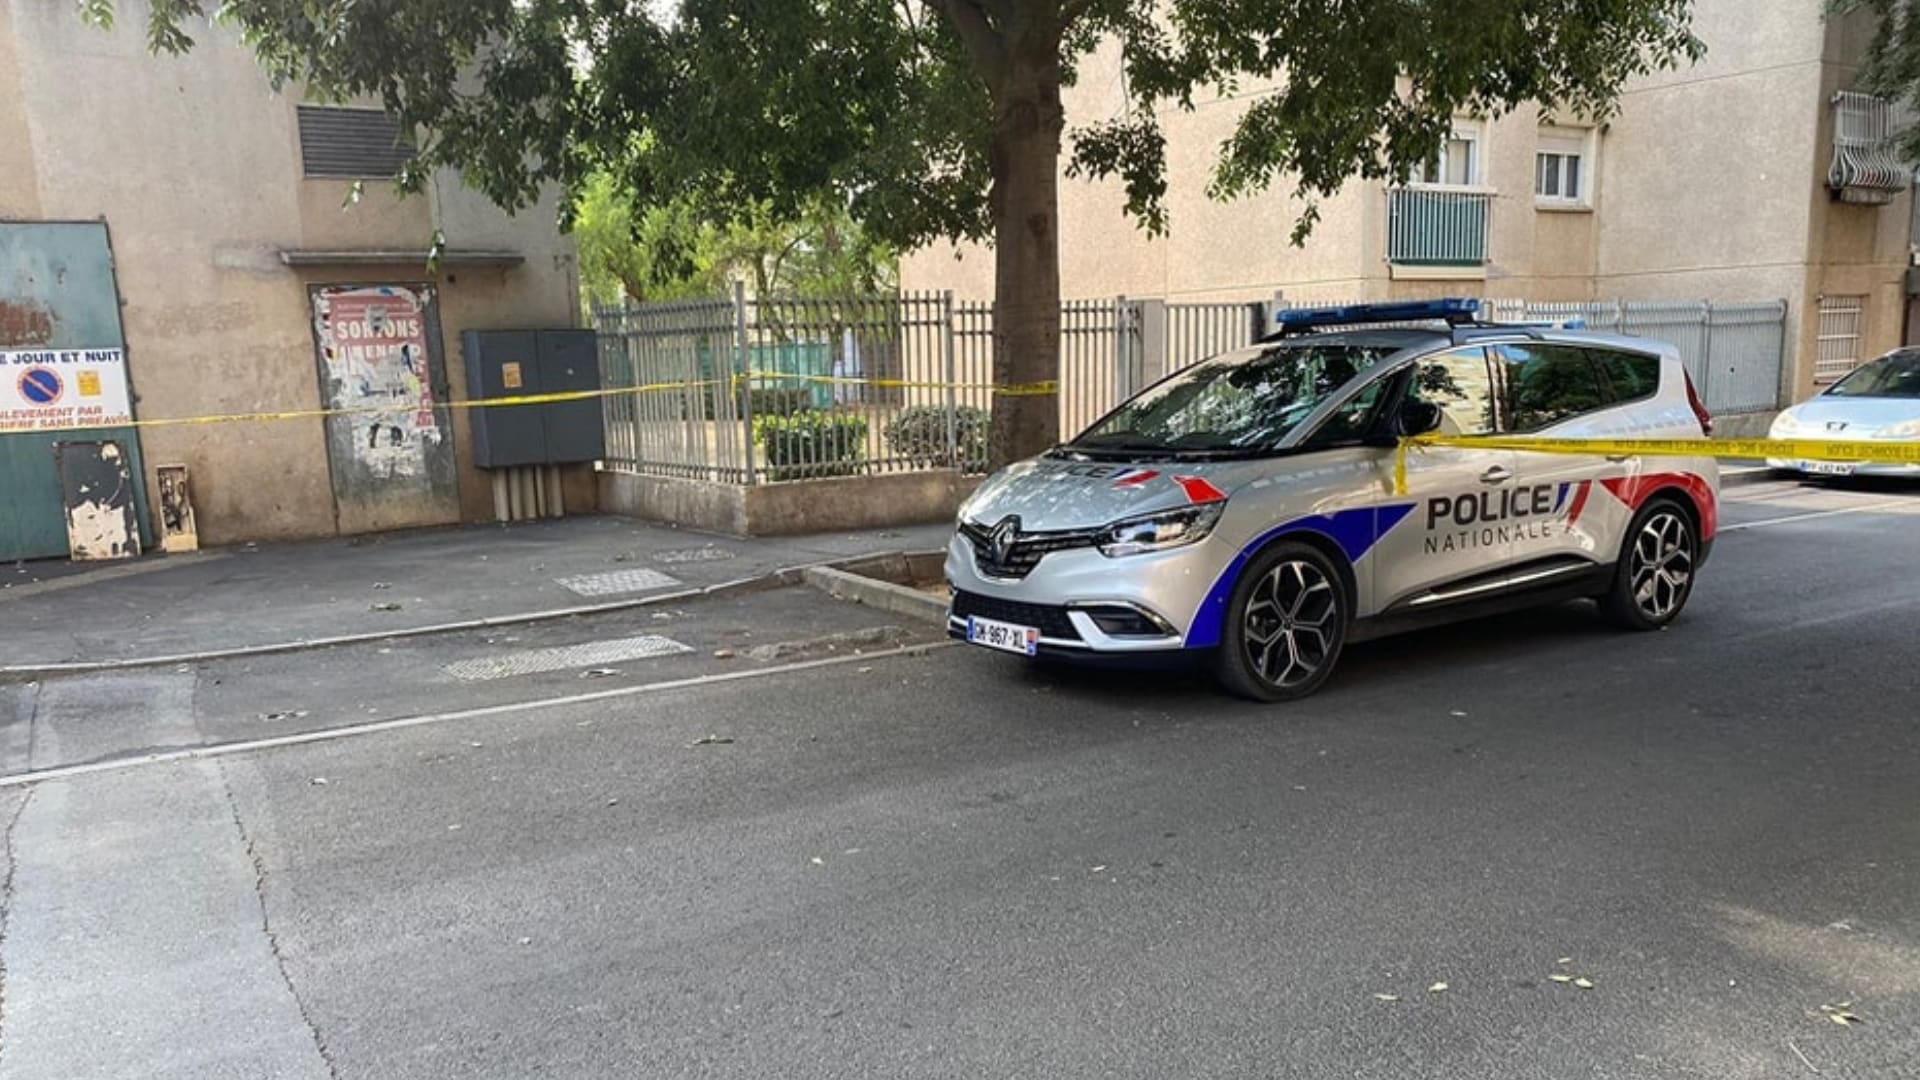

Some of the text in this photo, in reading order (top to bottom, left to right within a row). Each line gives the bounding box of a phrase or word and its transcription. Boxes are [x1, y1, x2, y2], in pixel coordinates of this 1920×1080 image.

[13, 352, 56, 364] JOUR
[61, 351, 80, 362] ET
[85, 351, 120, 362] NUIT
[77, 405, 103, 416] PAR
[40, 415, 74, 427] SANS
[1427, 484, 1552, 530] POLICE
[1424, 523, 1551, 555] NATIONALE
